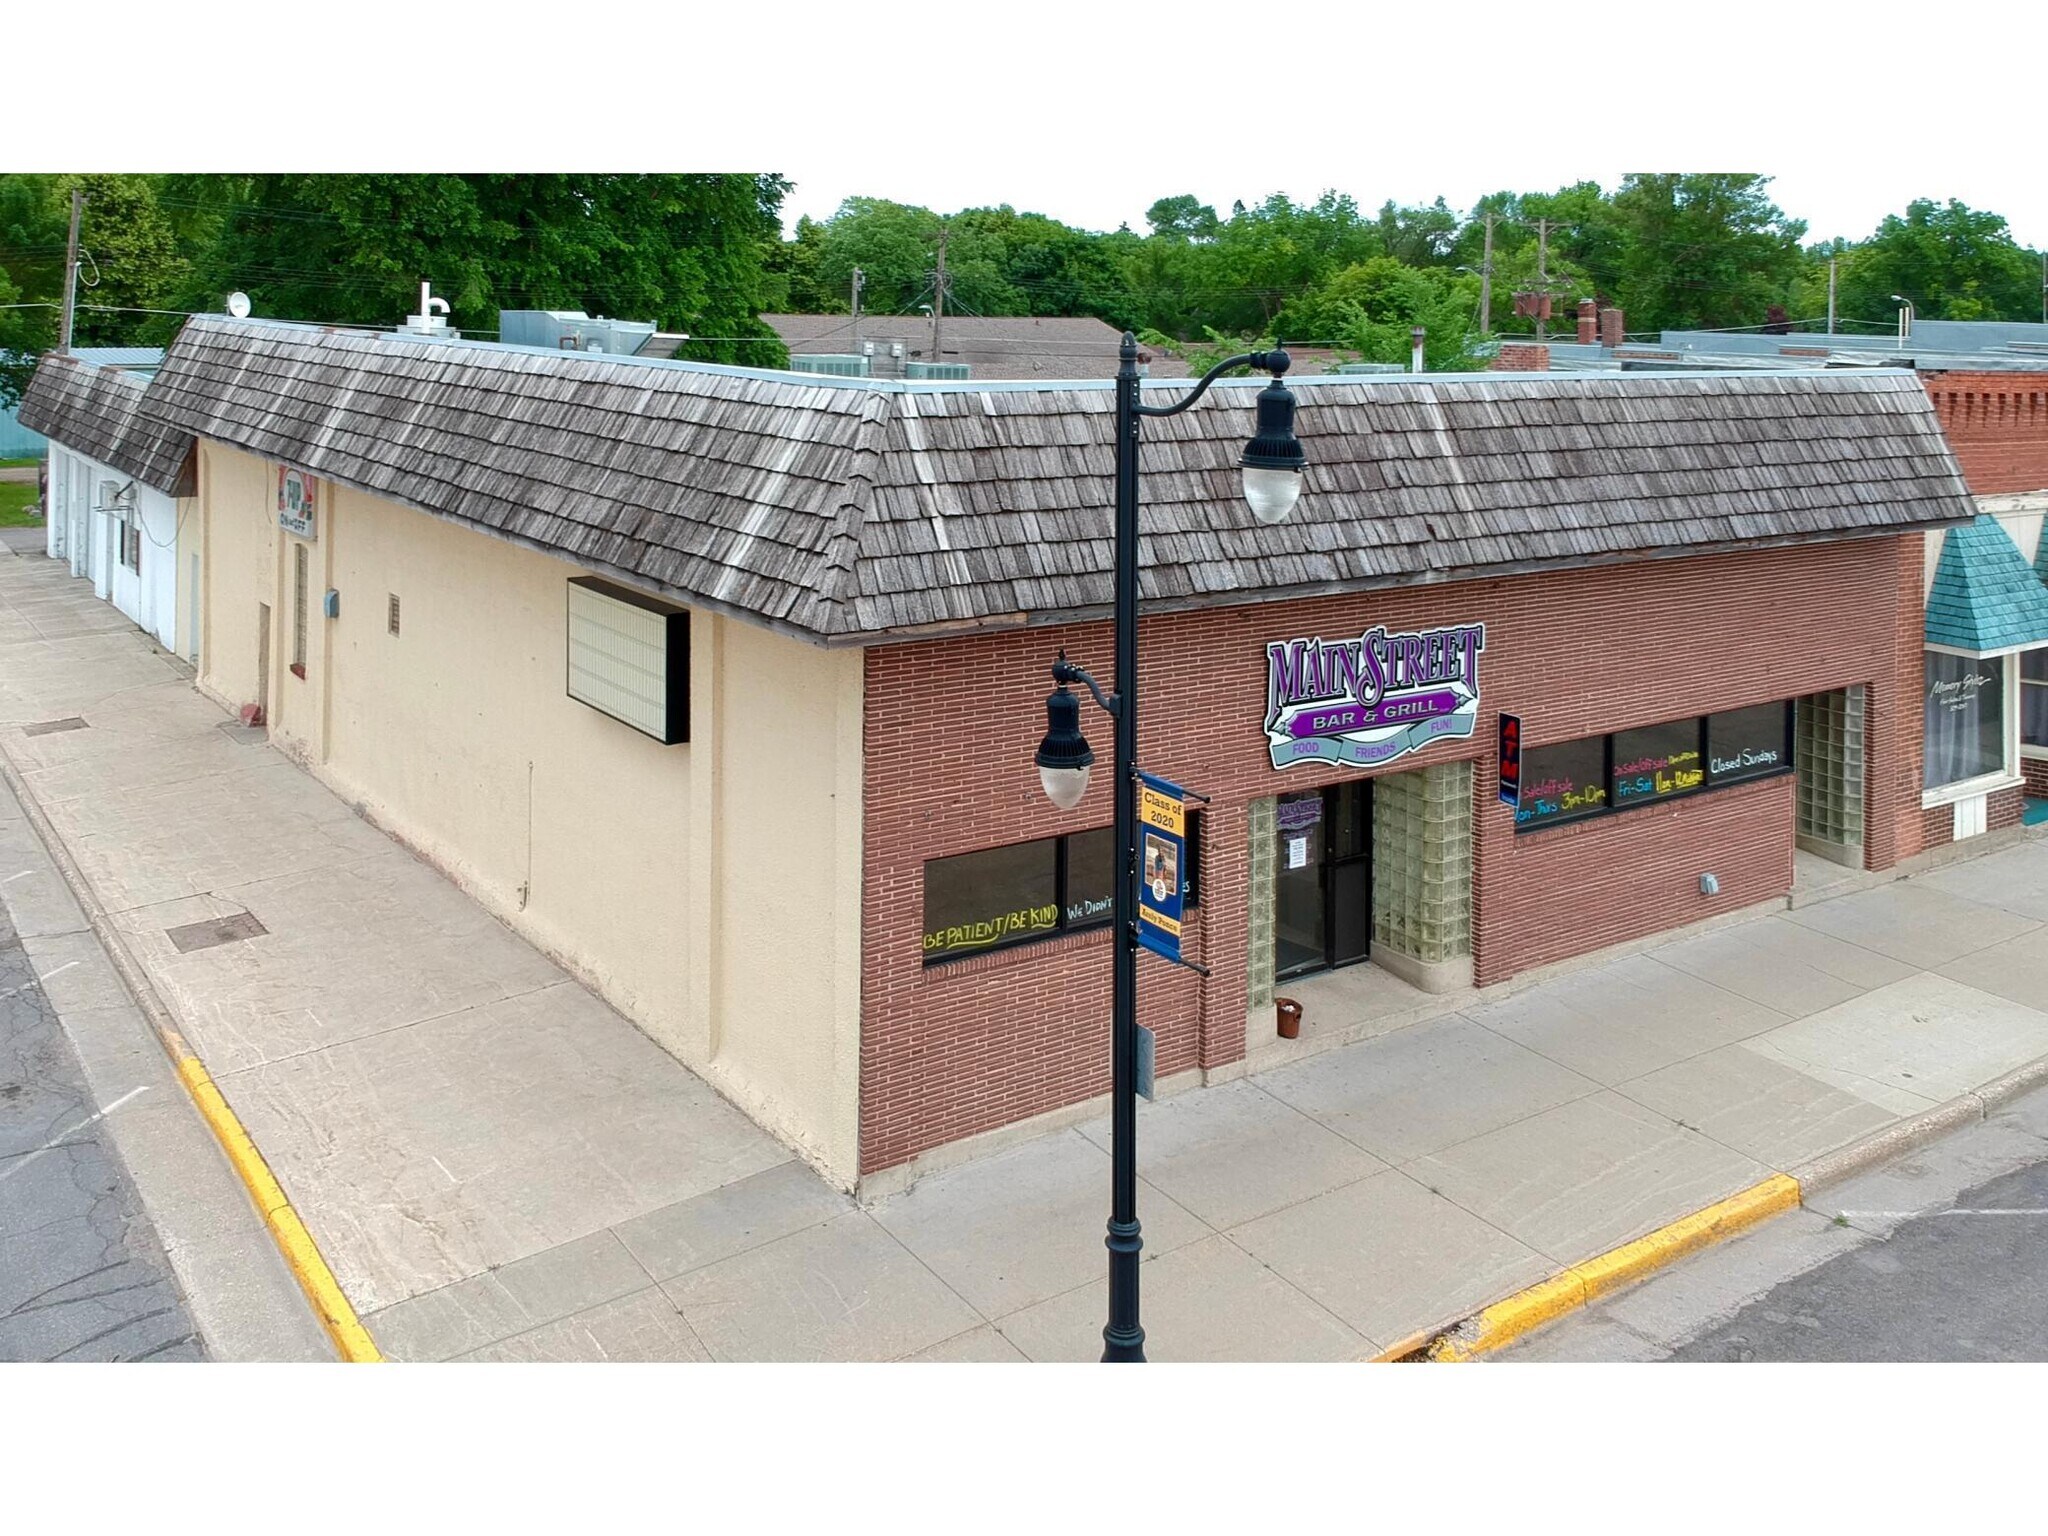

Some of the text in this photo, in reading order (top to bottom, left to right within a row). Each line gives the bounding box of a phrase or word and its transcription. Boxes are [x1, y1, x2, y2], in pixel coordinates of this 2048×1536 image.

[1313, 700, 1439, 730] BAR & GRILL
[1292, 718, 1453, 759] FOOD FRIENDS FUN!
[1502, 721, 1518, 779] ATM
[1711, 753, 1741, 774] Closed
[1742, 747, 1778, 766] Sundays
[1144, 792, 1182, 816] Class of
[1150, 810, 1175, 828] 2020
[923, 930, 945, 949] BE
[1030, 904, 1059, 925] KIND
